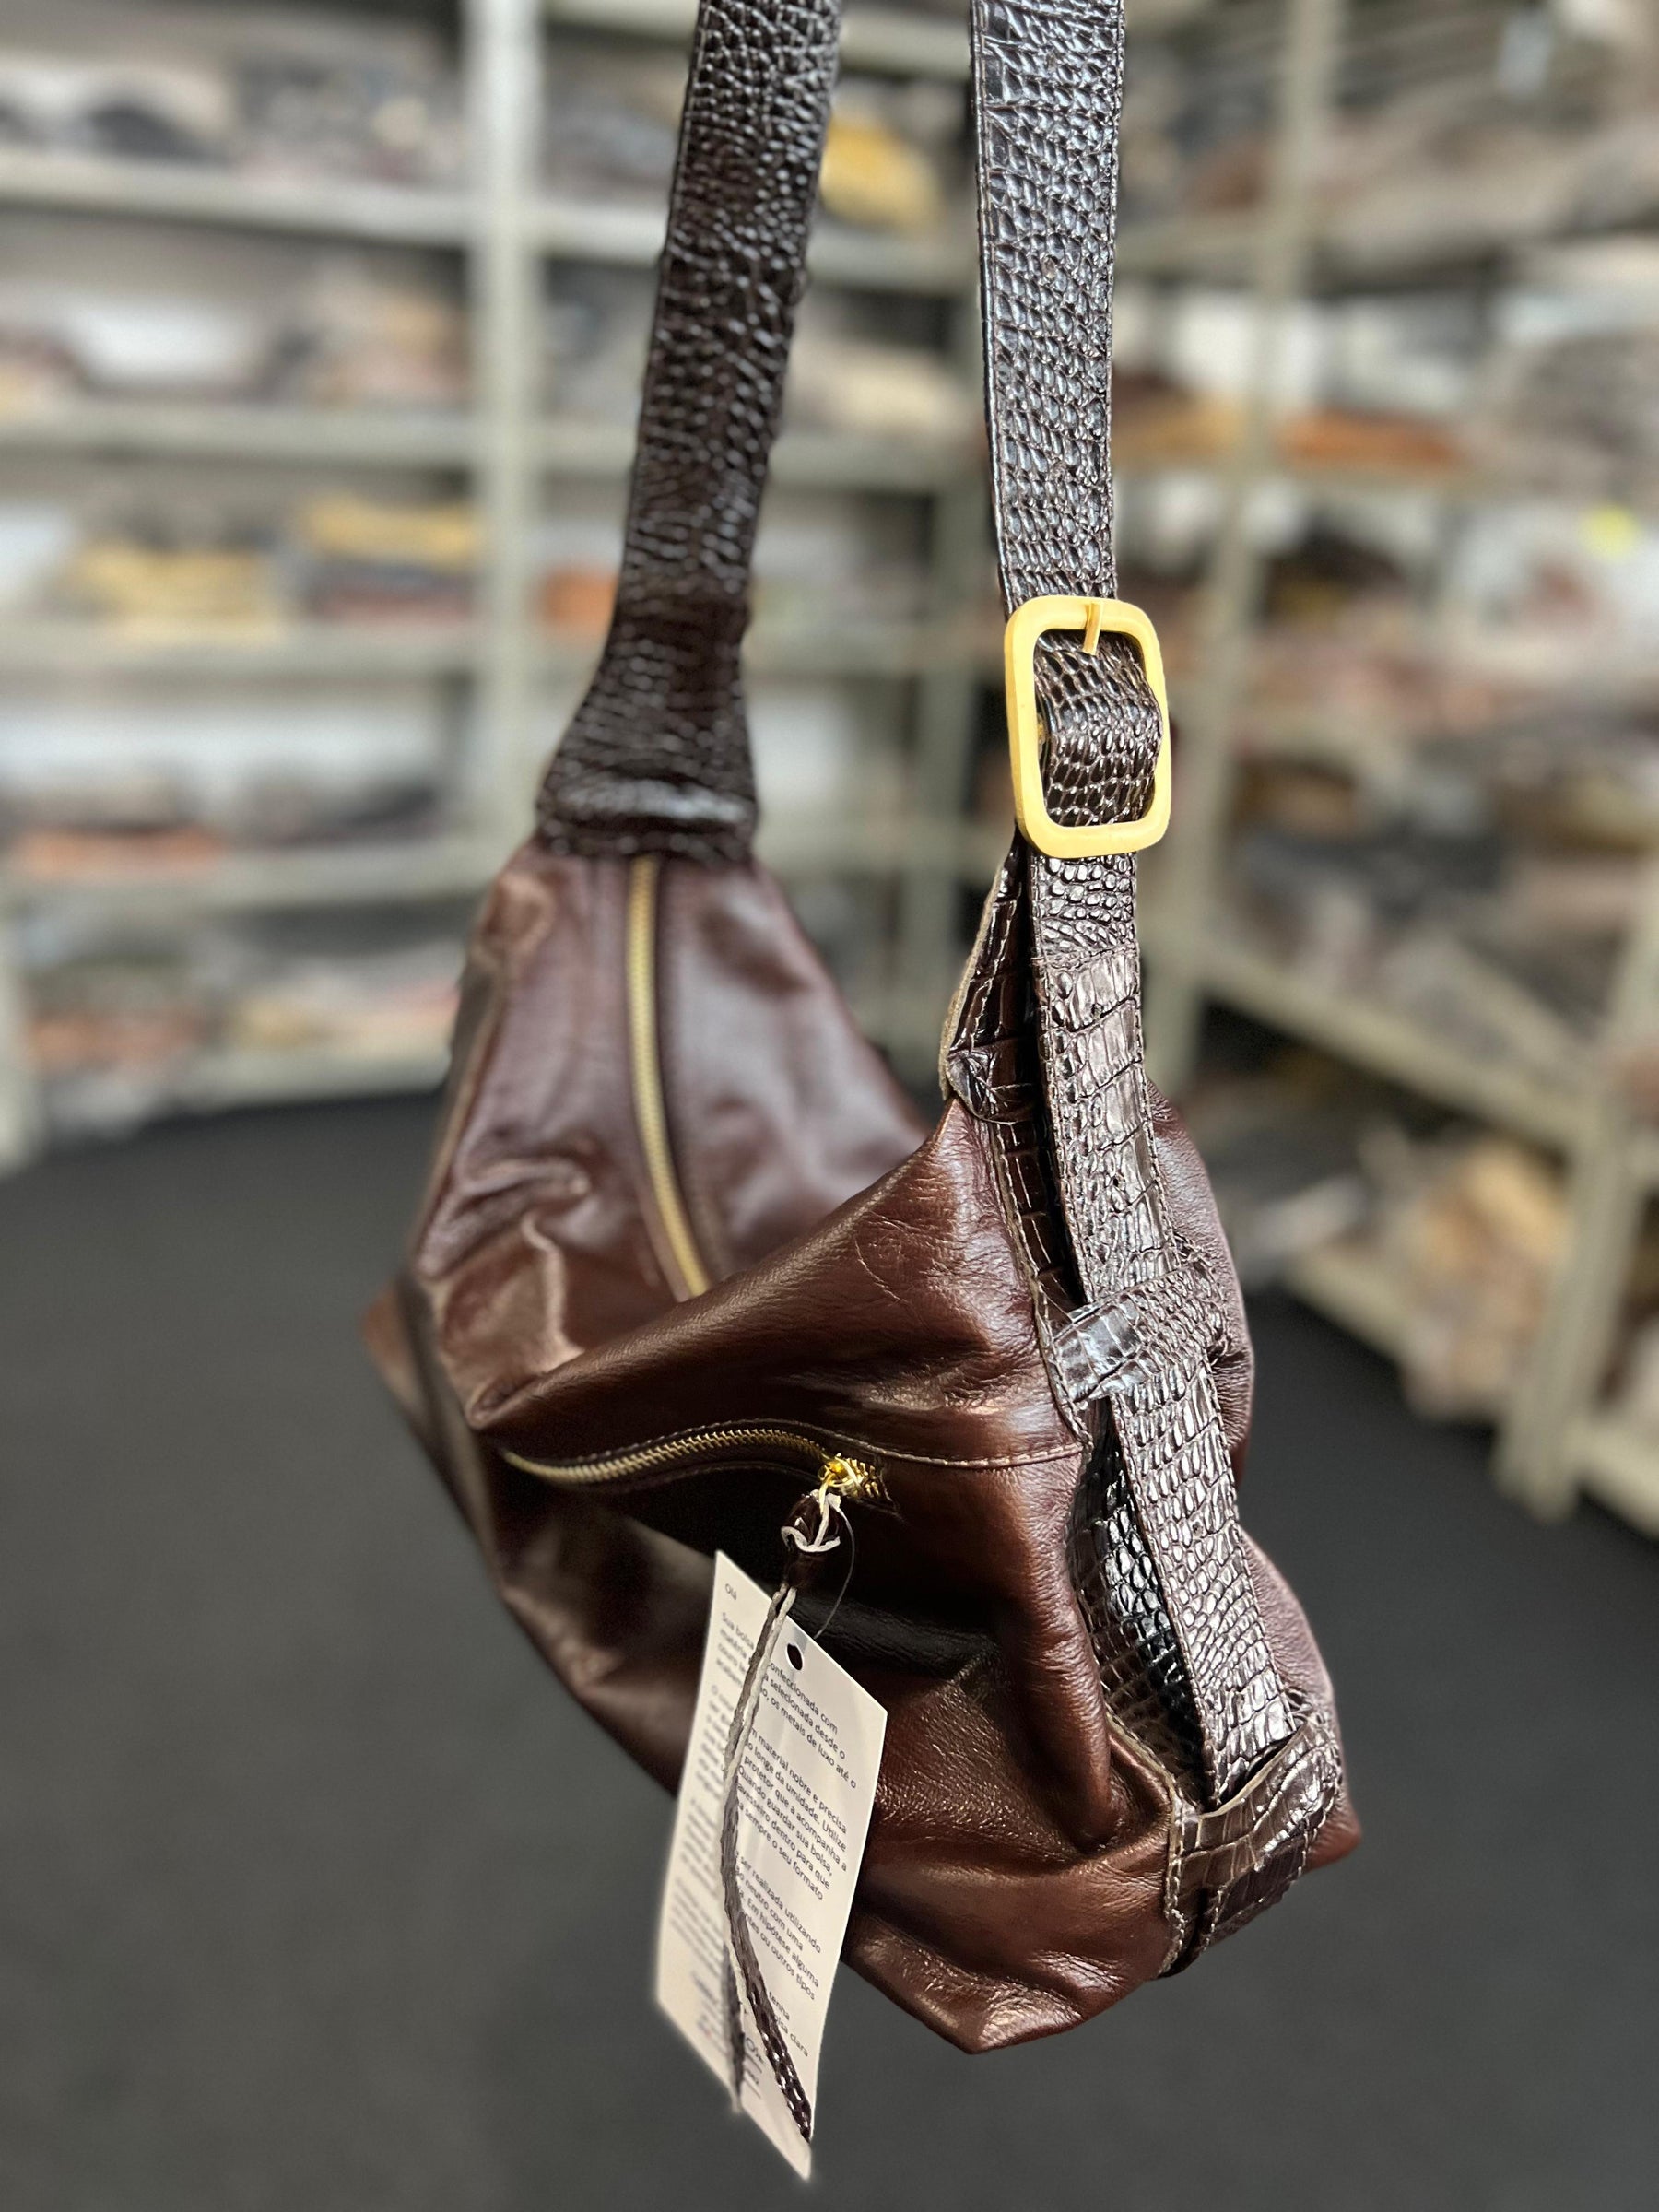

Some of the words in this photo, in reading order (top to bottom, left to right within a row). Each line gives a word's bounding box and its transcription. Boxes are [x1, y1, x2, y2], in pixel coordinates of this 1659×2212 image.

[768, 1662, 819, 1715] onfeccionada
[820, 1713, 837, 1734] com
[771, 1679, 813, 1726] selecionada
[815, 1725, 838, 1752] desde
[840, 1750, 845, 1759] o
[771, 1697, 780, 1710] os
[781, 1708, 805, 1736] metais
[807, 1735, 817, 1747] de
[818, 1744, 834, 1766] luxo
[836, 1765, 849, 1781] até
[851, 1780, 856, 1788] o
[744, 1756, 774, 1790] protetor
[775, 1790, 789, 1807] que
[796, 1813, 840, 1865] acompanha
[755, 1747, 773, 1773] longe
[775, 1771, 784, 1784] da
[822, 1820, 846, 1852] Utilize
[759, 1735, 788, 1771] material
[789, 1770, 811, 1796] nobre
[813, 1794, 818, 1803] e
[819, 1801, 846, 1834] precisa
[767, 1798, 795, 1831] guardar
[796, 1830, 809, 1848] sua
[737, 1783, 771, 1821] avesseiro
[771, 1821, 795, 1851] dentro
[796, 1850, 813, 1872] para
[815, 1870, 830, 1889] que
[745, 1809, 771, 1841] sempre
[779, 1847, 792, 1865] seu
[793, 1861, 823, 1900] formato
[746, 1880, 769, 1910] neutro
[770, 1909, 785, 1930] com
[787, 1928, 803, 1951] uma
[752, 1871, 783, 1910] realizada
[785, 1908, 820, 1953] utilizando
[759, 1912, 790, 1954] hipótese
[792, 1953, 818, 1987] alguma
[760, 1933, 771, 1947] ou
[771, 1946, 794, 1976] outros
[796, 1974, 814, 2000] tipos
[790, 2033, 808, 2056] clara
